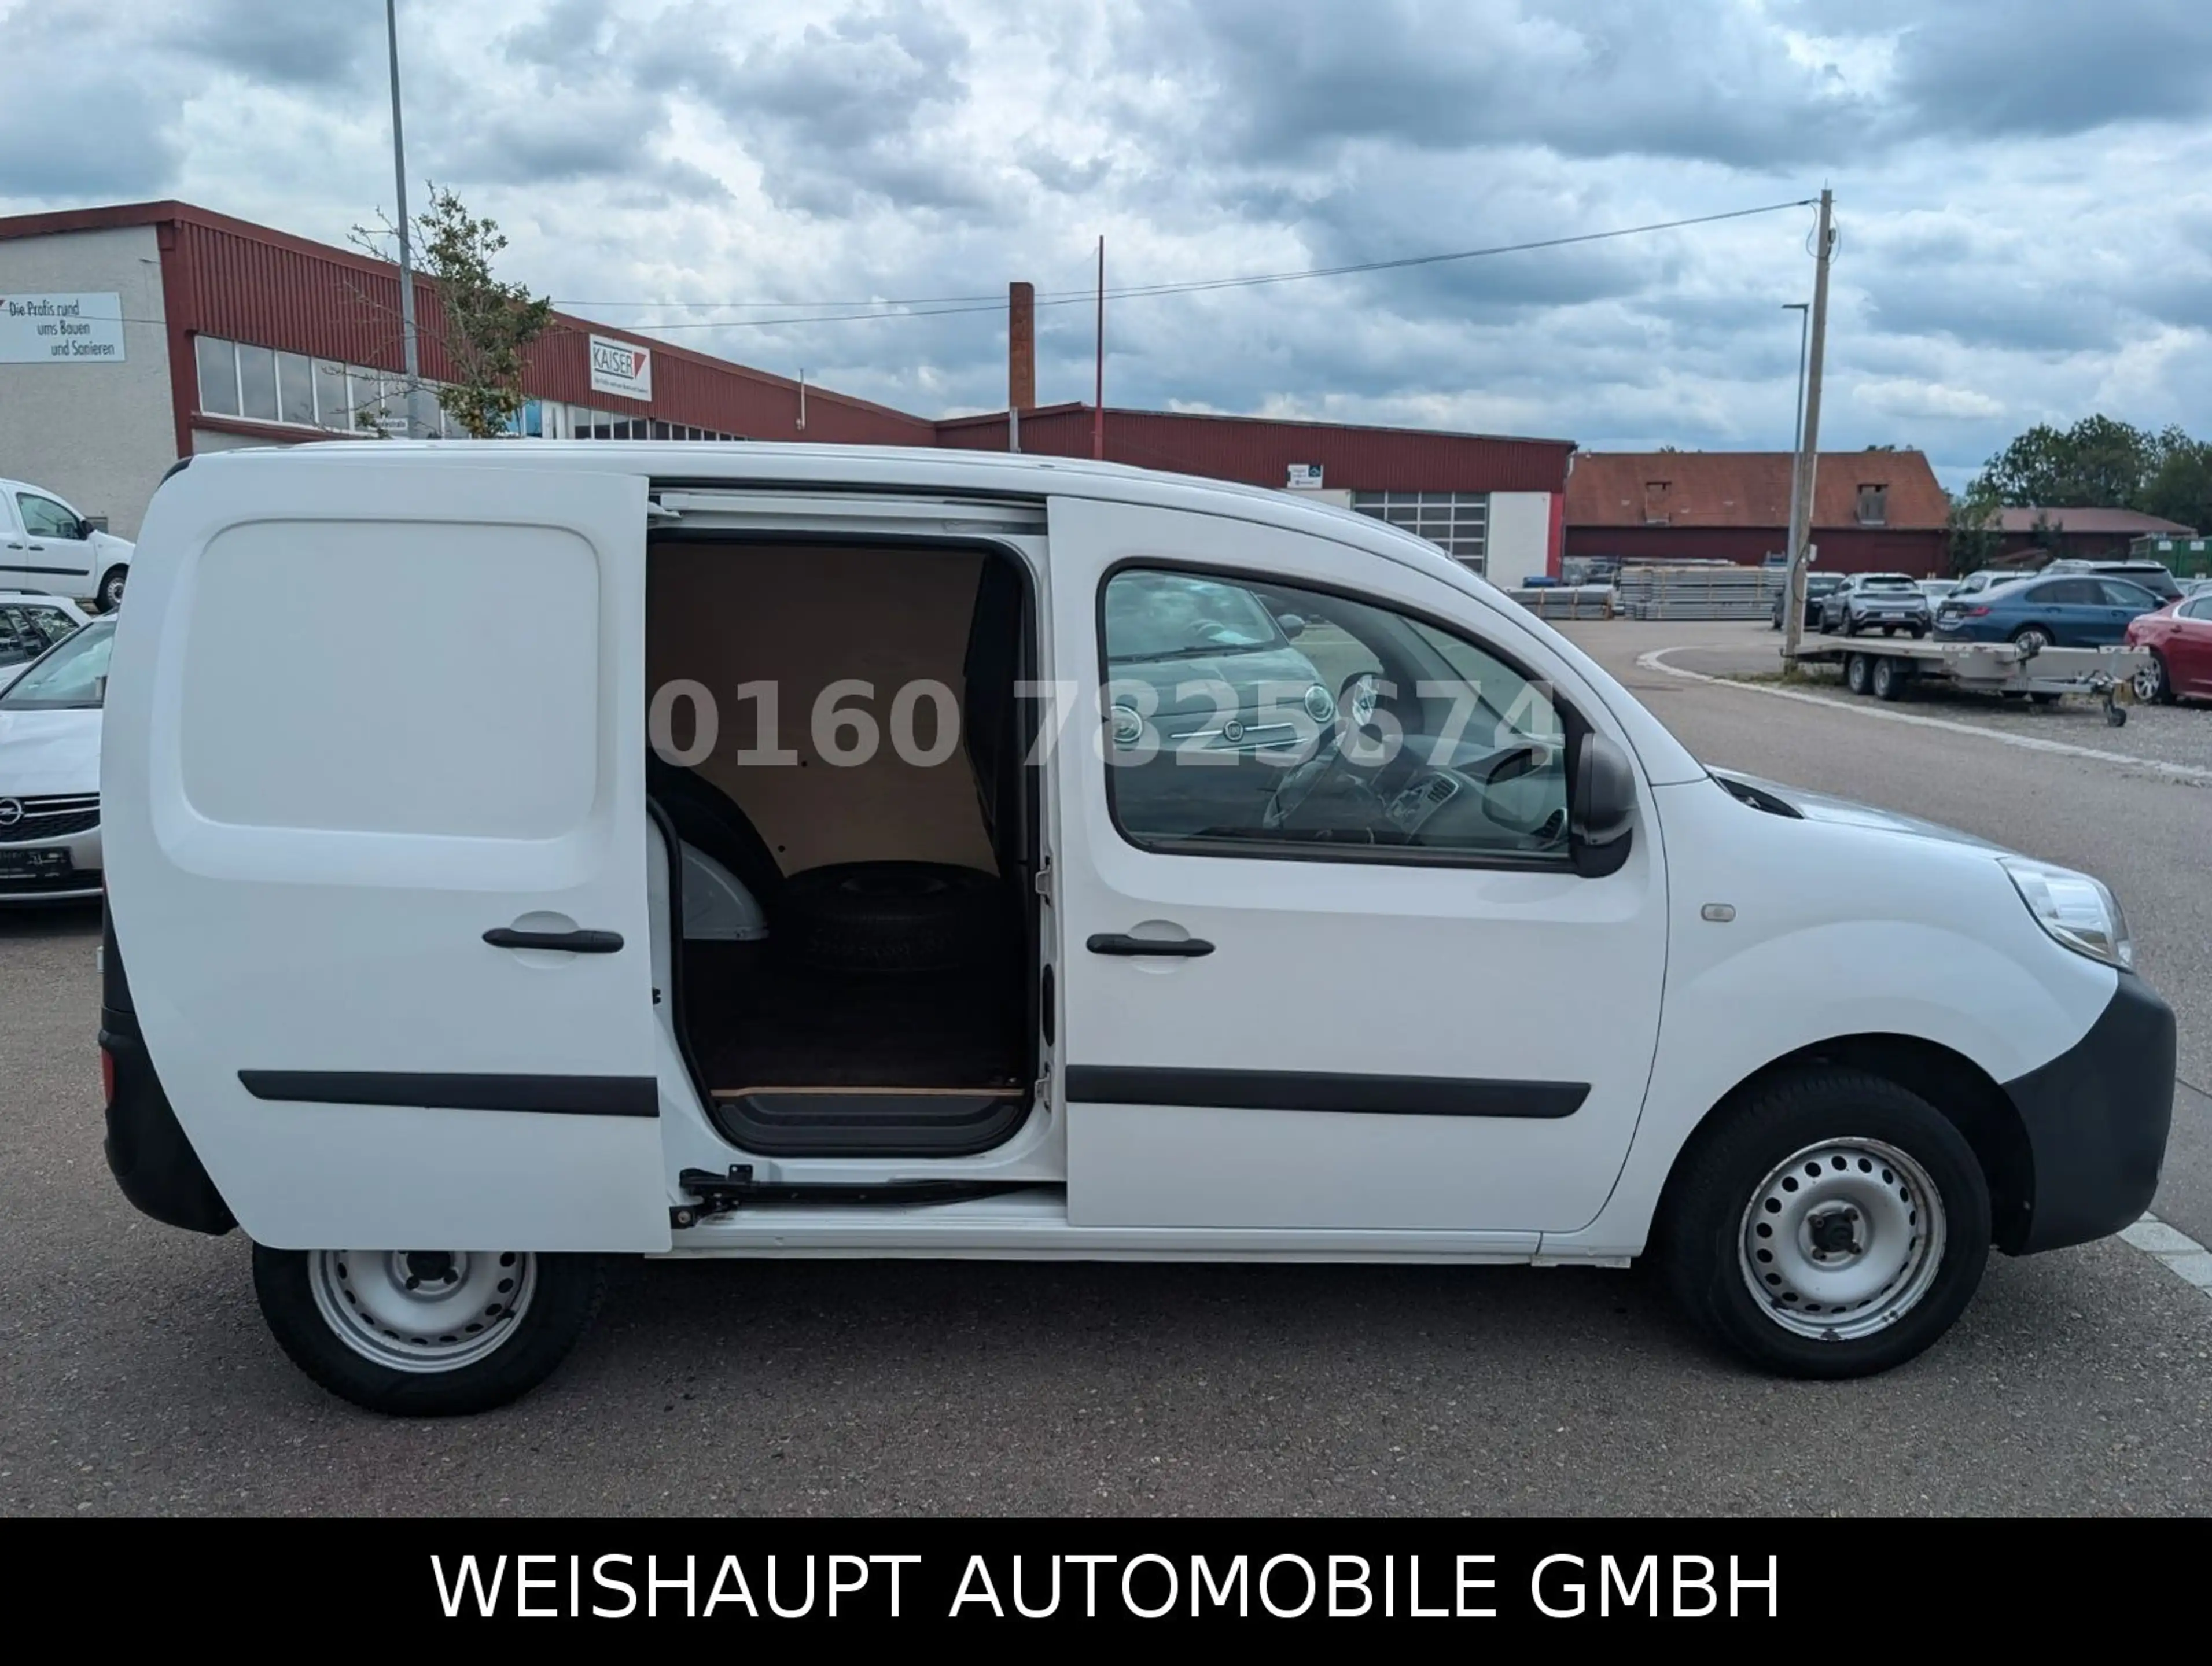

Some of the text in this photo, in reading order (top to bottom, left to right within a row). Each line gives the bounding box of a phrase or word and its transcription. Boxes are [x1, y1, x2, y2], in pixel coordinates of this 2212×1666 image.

[9, 299, 80, 316] Die Profis rund
[37, 319, 90, 336] ums Bauen
[51, 338, 115, 356] und Sanieren
[593, 346, 633, 375] KAISER
